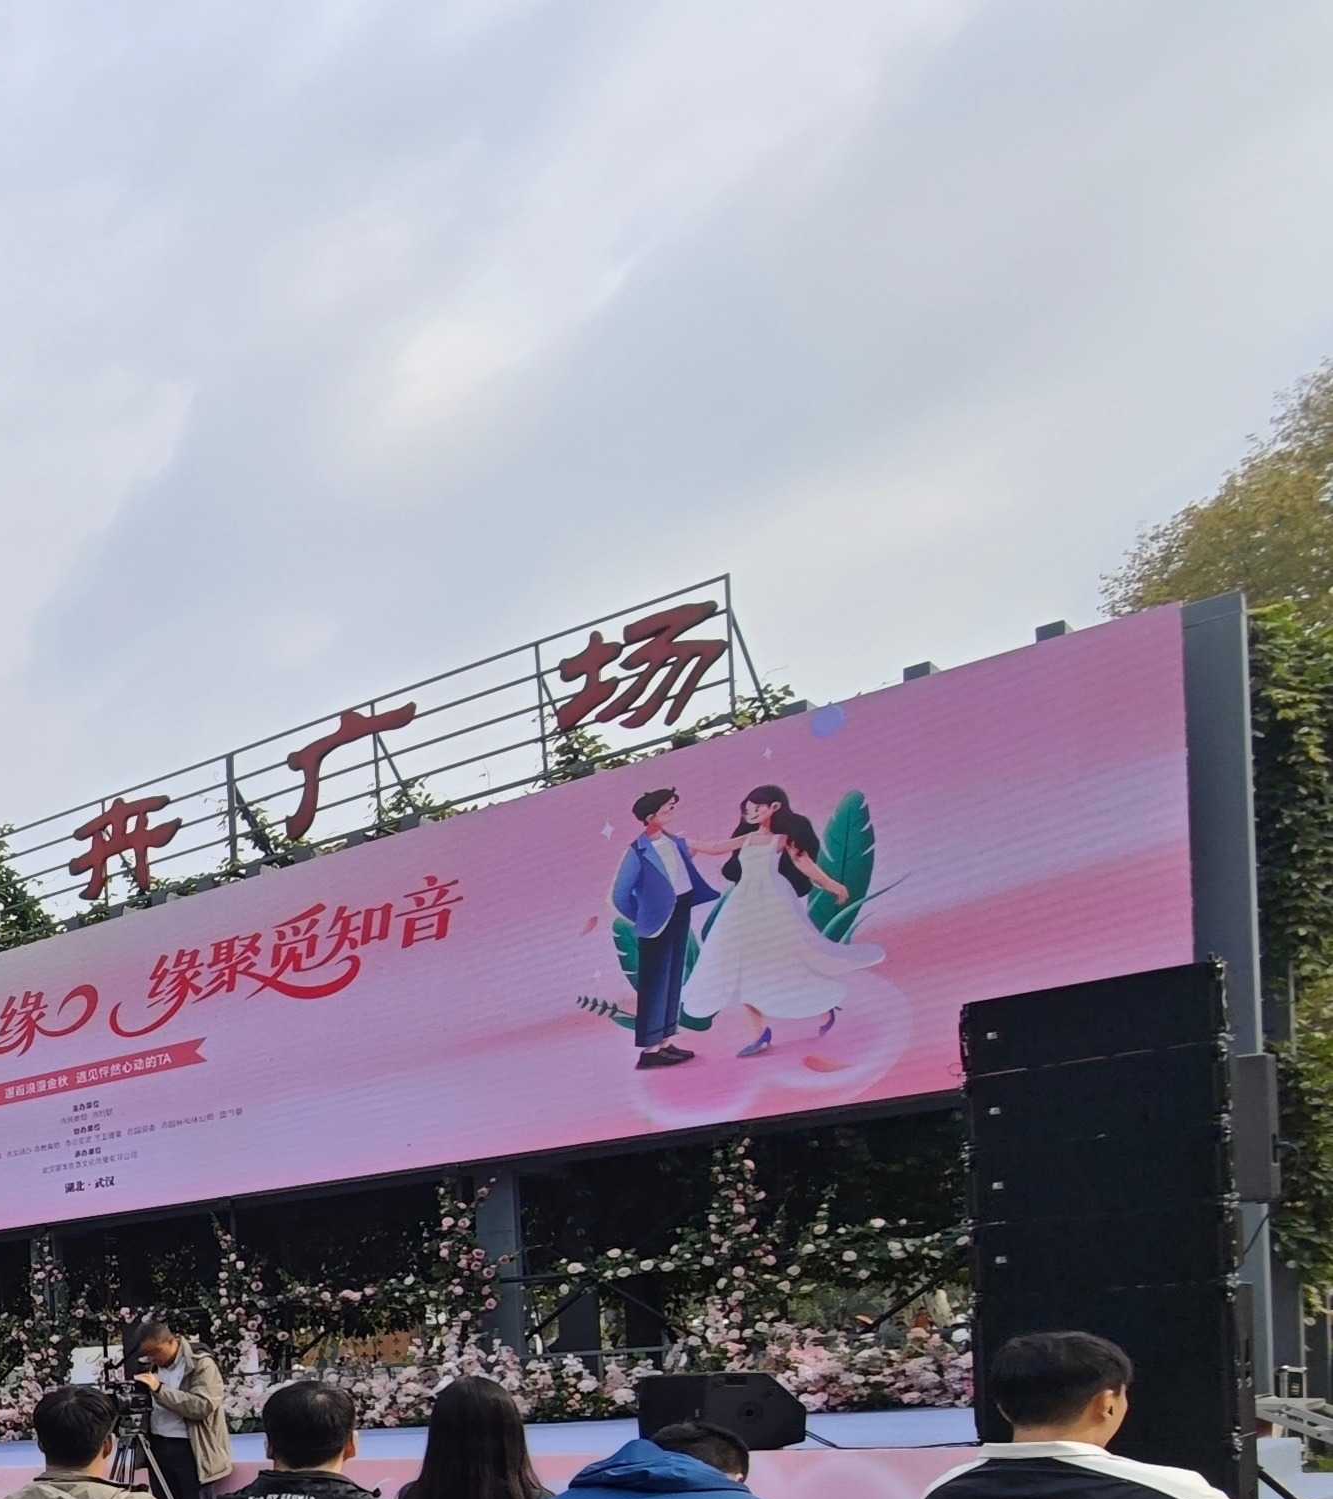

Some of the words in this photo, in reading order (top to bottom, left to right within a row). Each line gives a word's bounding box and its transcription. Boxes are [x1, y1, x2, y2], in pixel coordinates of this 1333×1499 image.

[109, 875, 464, 1037] 缘聚觅知音
